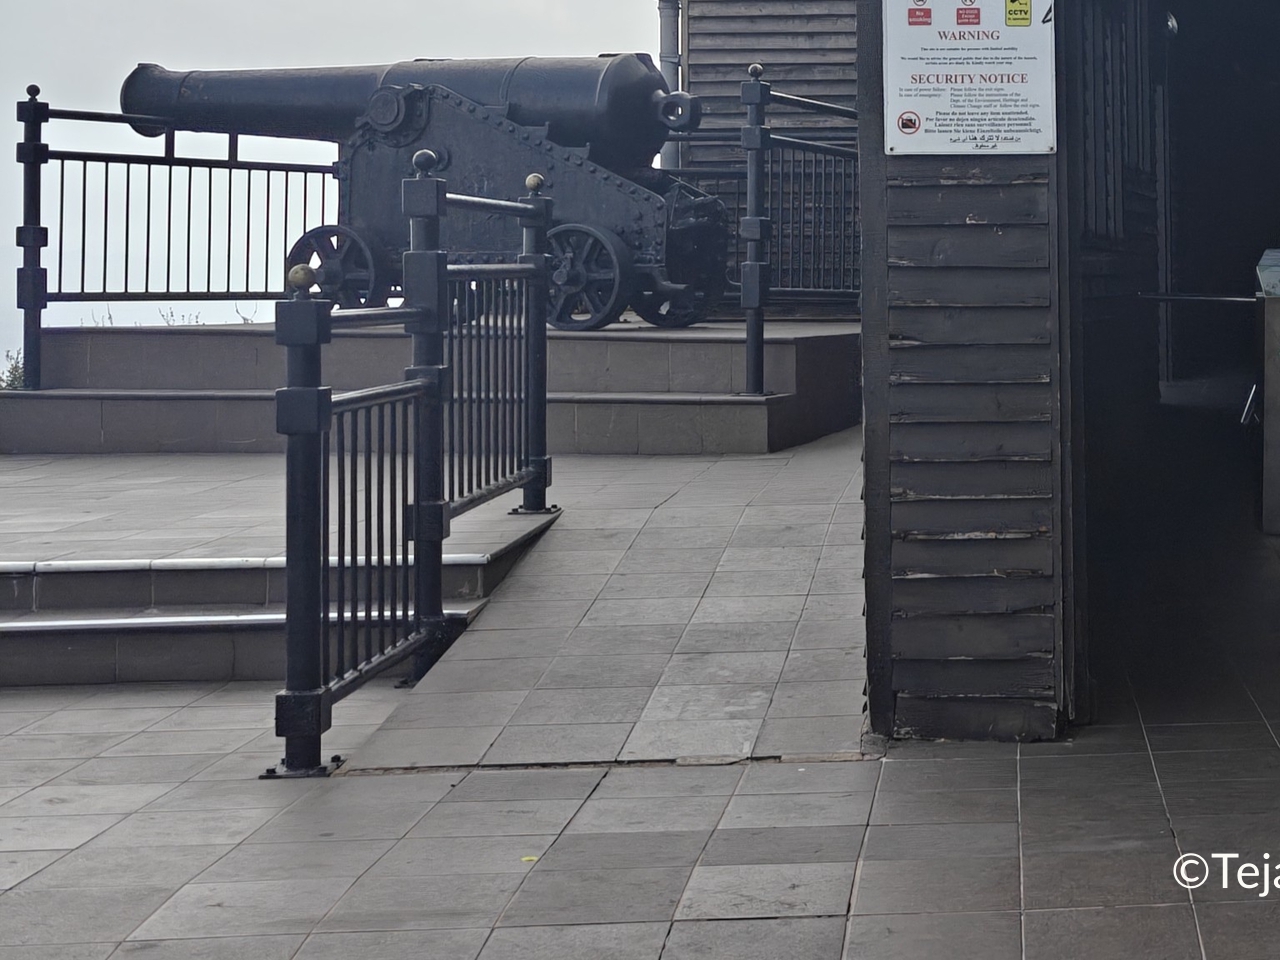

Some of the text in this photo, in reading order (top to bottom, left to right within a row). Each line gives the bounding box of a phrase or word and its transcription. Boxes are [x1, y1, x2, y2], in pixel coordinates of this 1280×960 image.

[938, 30, 1000, 40] WARNING
[910, 73, 1028, 84] SECURITY NOTICE
